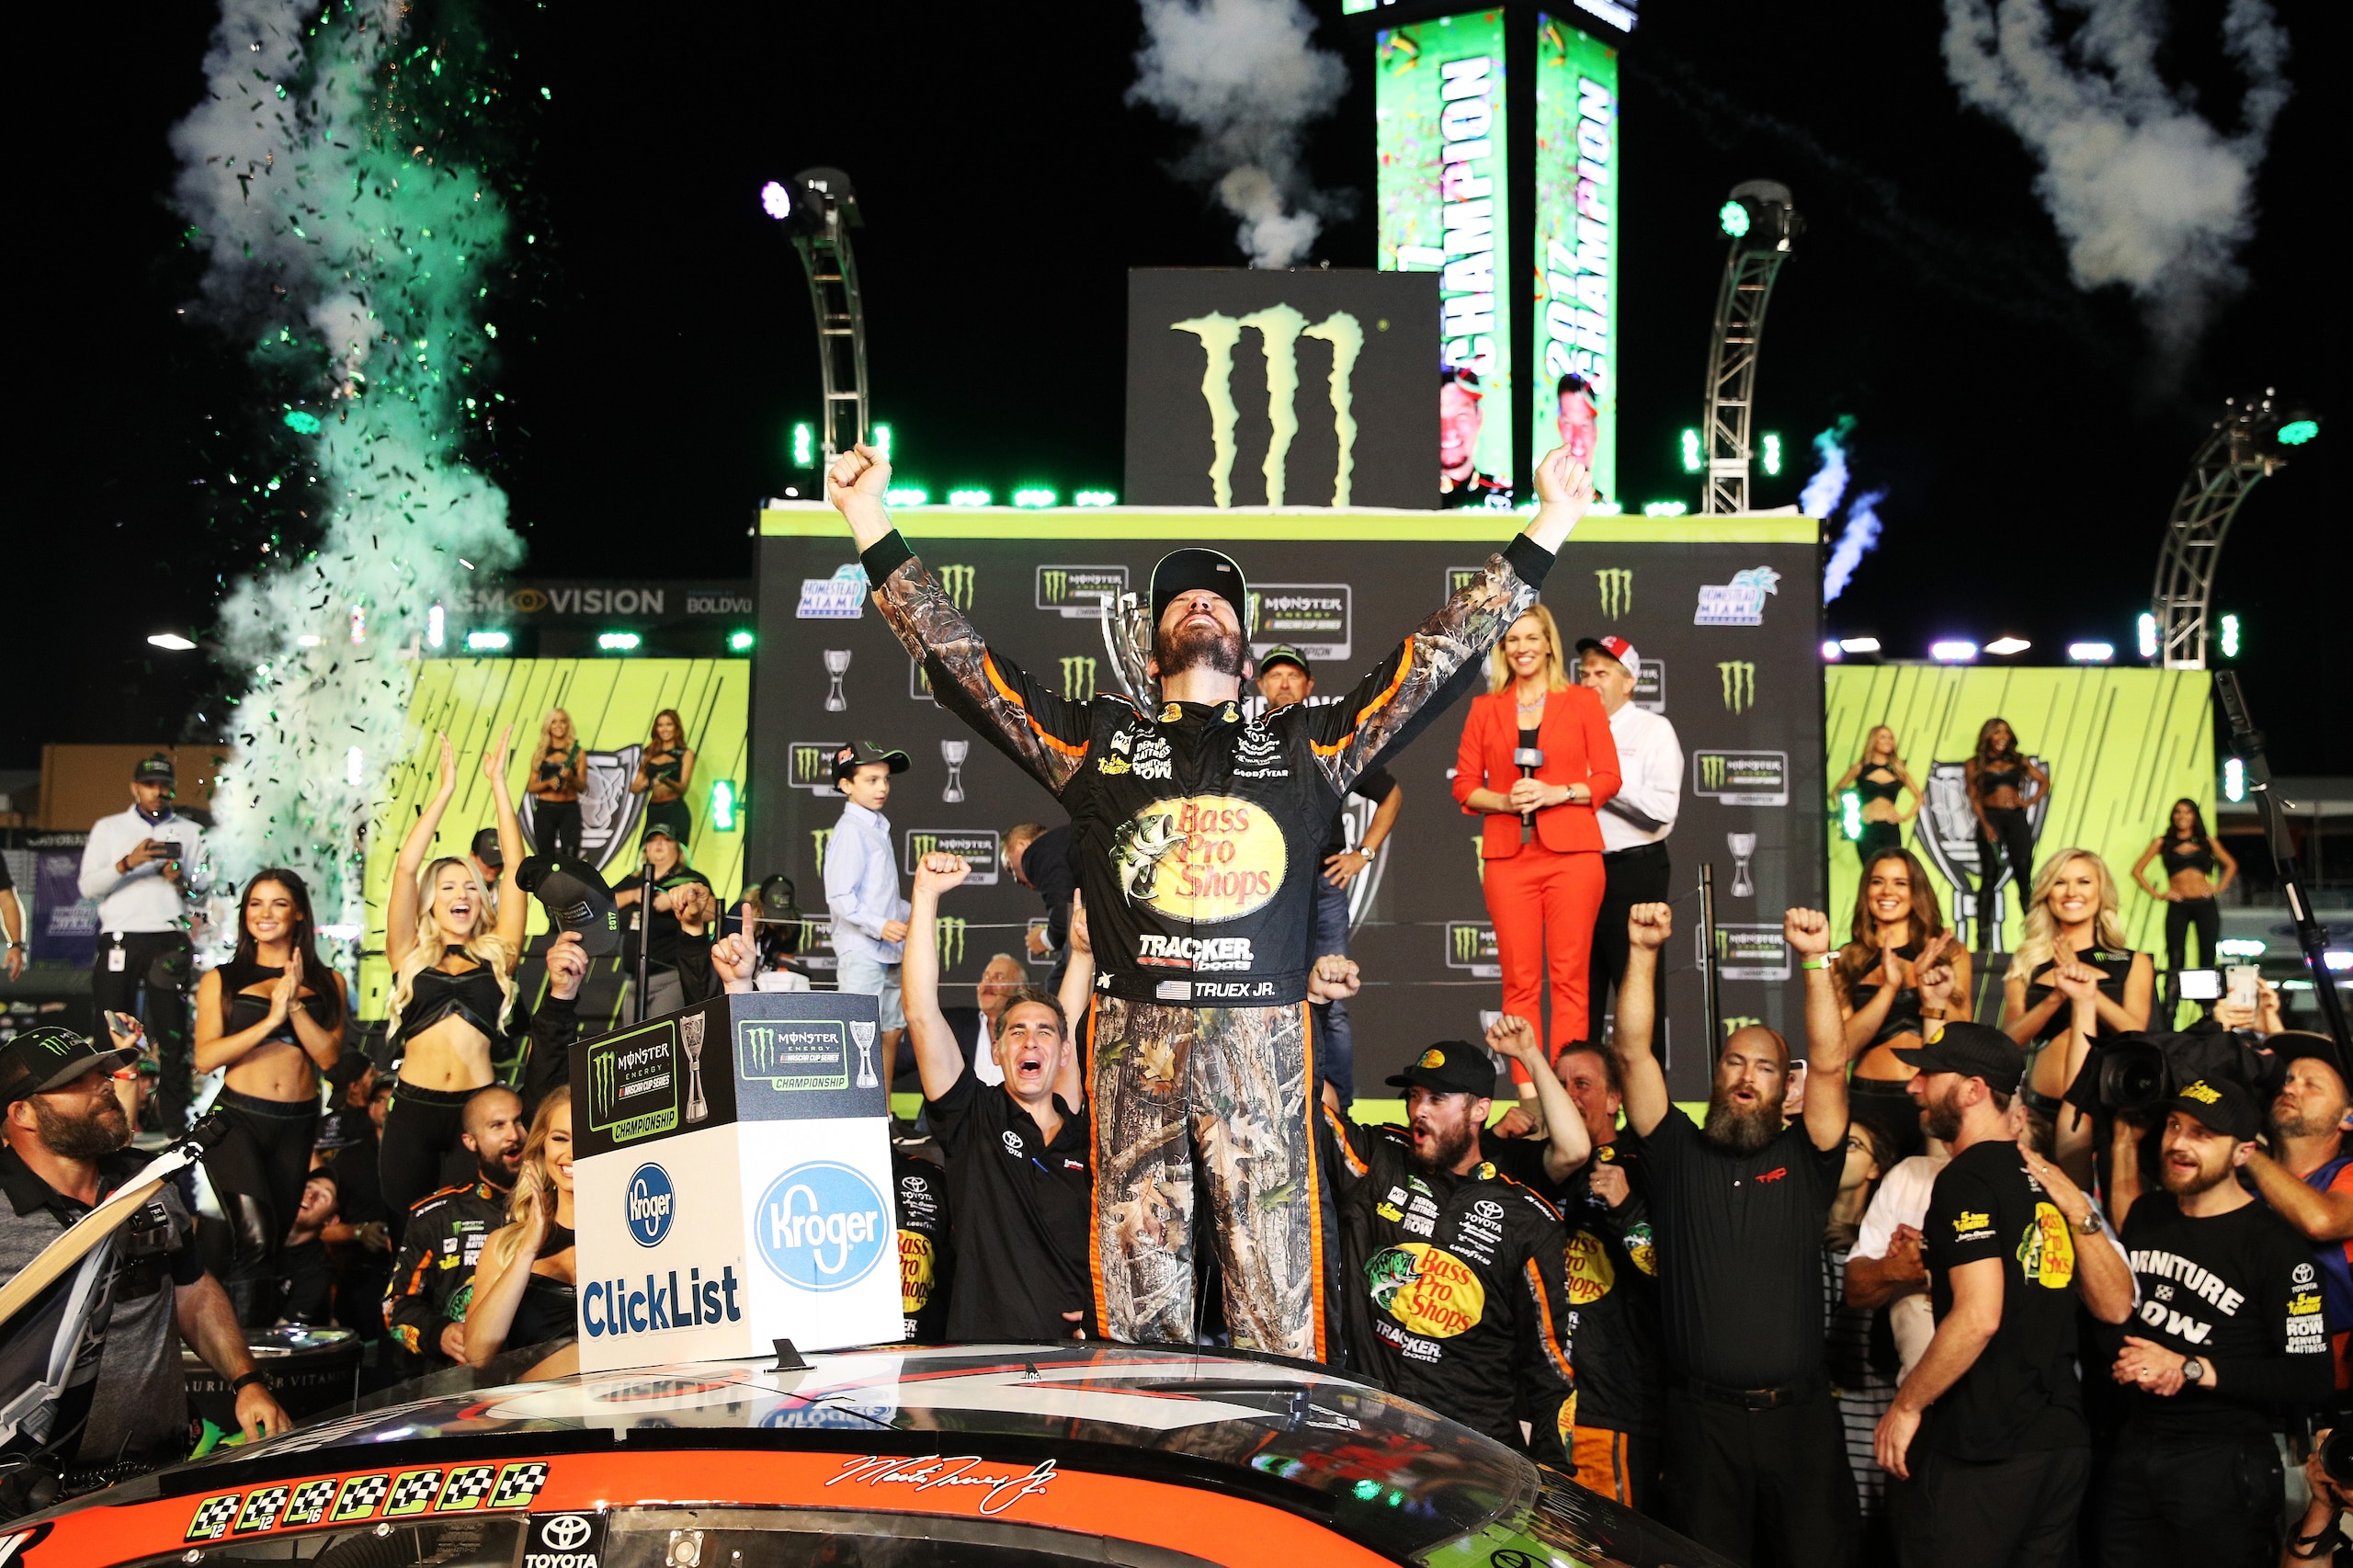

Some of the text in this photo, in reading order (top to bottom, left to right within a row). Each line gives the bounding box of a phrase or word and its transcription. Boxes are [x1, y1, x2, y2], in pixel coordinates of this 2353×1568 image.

[1440, 55, 1497, 378] CHAMPION
[1575, 76, 1612, 396] CHAMPION
[1544, 237, 1580, 379] 2017
[803, 582, 859, 595] HOMESTEAD
[548, 588, 665, 614] VISION
[802, 597, 855, 608] MIAMI
[1265, 597, 1342, 612] MONSTER
[1233, 768, 1289, 779] GOODYEAR
[1176, 801, 1249, 834] Bass
[938, 838, 994, 850] MONSTER
[1176, 834, 1236, 864] Pro
[1176, 864, 1271, 905] Shops
[608, 911, 618, 931] 2017
[1196, 960, 1252, 971] boats
[1195, 982, 1276, 997] TRUEX JR.
[778, 1031, 839, 1045] MONSTER
[618, 1041, 670, 1072] MONSTER
[788, 1054, 809, 1062] NASCAR
[810, 1054, 820, 1062] CUP
[625, 1064, 663, 1081] ENERGY
[776, 1076, 845, 1089] CHAMPIONSHIP
[615, 1110, 676, 1140] CHAMPIONSHIP
[901, 1191, 934, 1201] TOYOTA
[629, 1177, 672, 1237] Kroger
[770, 1184, 879, 1275] Kroger
[1464, 1212, 1502, 1233] TOYOTA
[1449, 1244, 1491, 1266] GOODYEAR
[1419, 1249, 1473, 1286] Bass
[1415, 1273, 1453, 1301] Pro
[2291, 1282, 2318, 1293] TOYOTA
[582, 1266, 742, 1338] ClickList
[1410, 1294, 1473, 1333] Shops
[2140, 1300, 2213, 1345] OW
[2286, 1322, 2325, 1336] ROW
[2286, 1343, 2327, 1354] MATTRESS
[2288, 1335, 2323, 1346] DENVER
[258, 1515, 275, 1531] 12
[306, 1508, 323, 1524] 16
[210, 1523, 226, 1540] 12
[525, 1554, 598, 1568] TOYOTA
